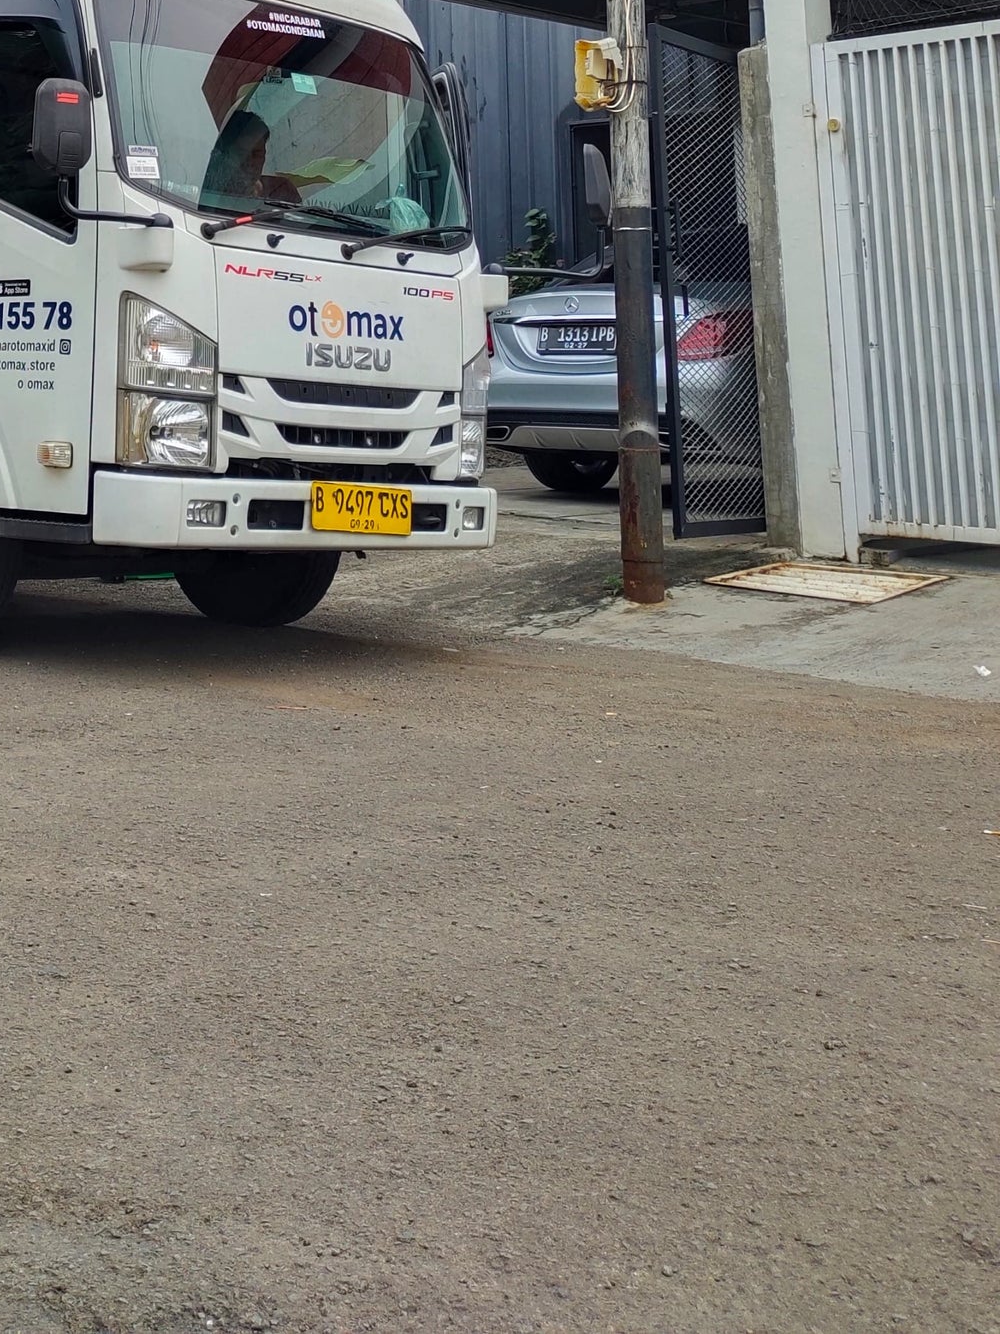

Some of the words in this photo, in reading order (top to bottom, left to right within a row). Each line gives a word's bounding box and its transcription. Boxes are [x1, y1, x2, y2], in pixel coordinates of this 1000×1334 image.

[4, 287, 14, 295] App
[15, 286, 28, 294] Store
[42, 301, 73, 330] 78
[540, 327, 549, 342] B
[557, 327, 589, 342] 1313
[590, 326, 615, 342] IPB
[305, 342, 391, 372] ISUZU
[315, 486, 325, 512] B
[332, 488, 374, 516] 9497
[378, 492, 409, 519] CXS
